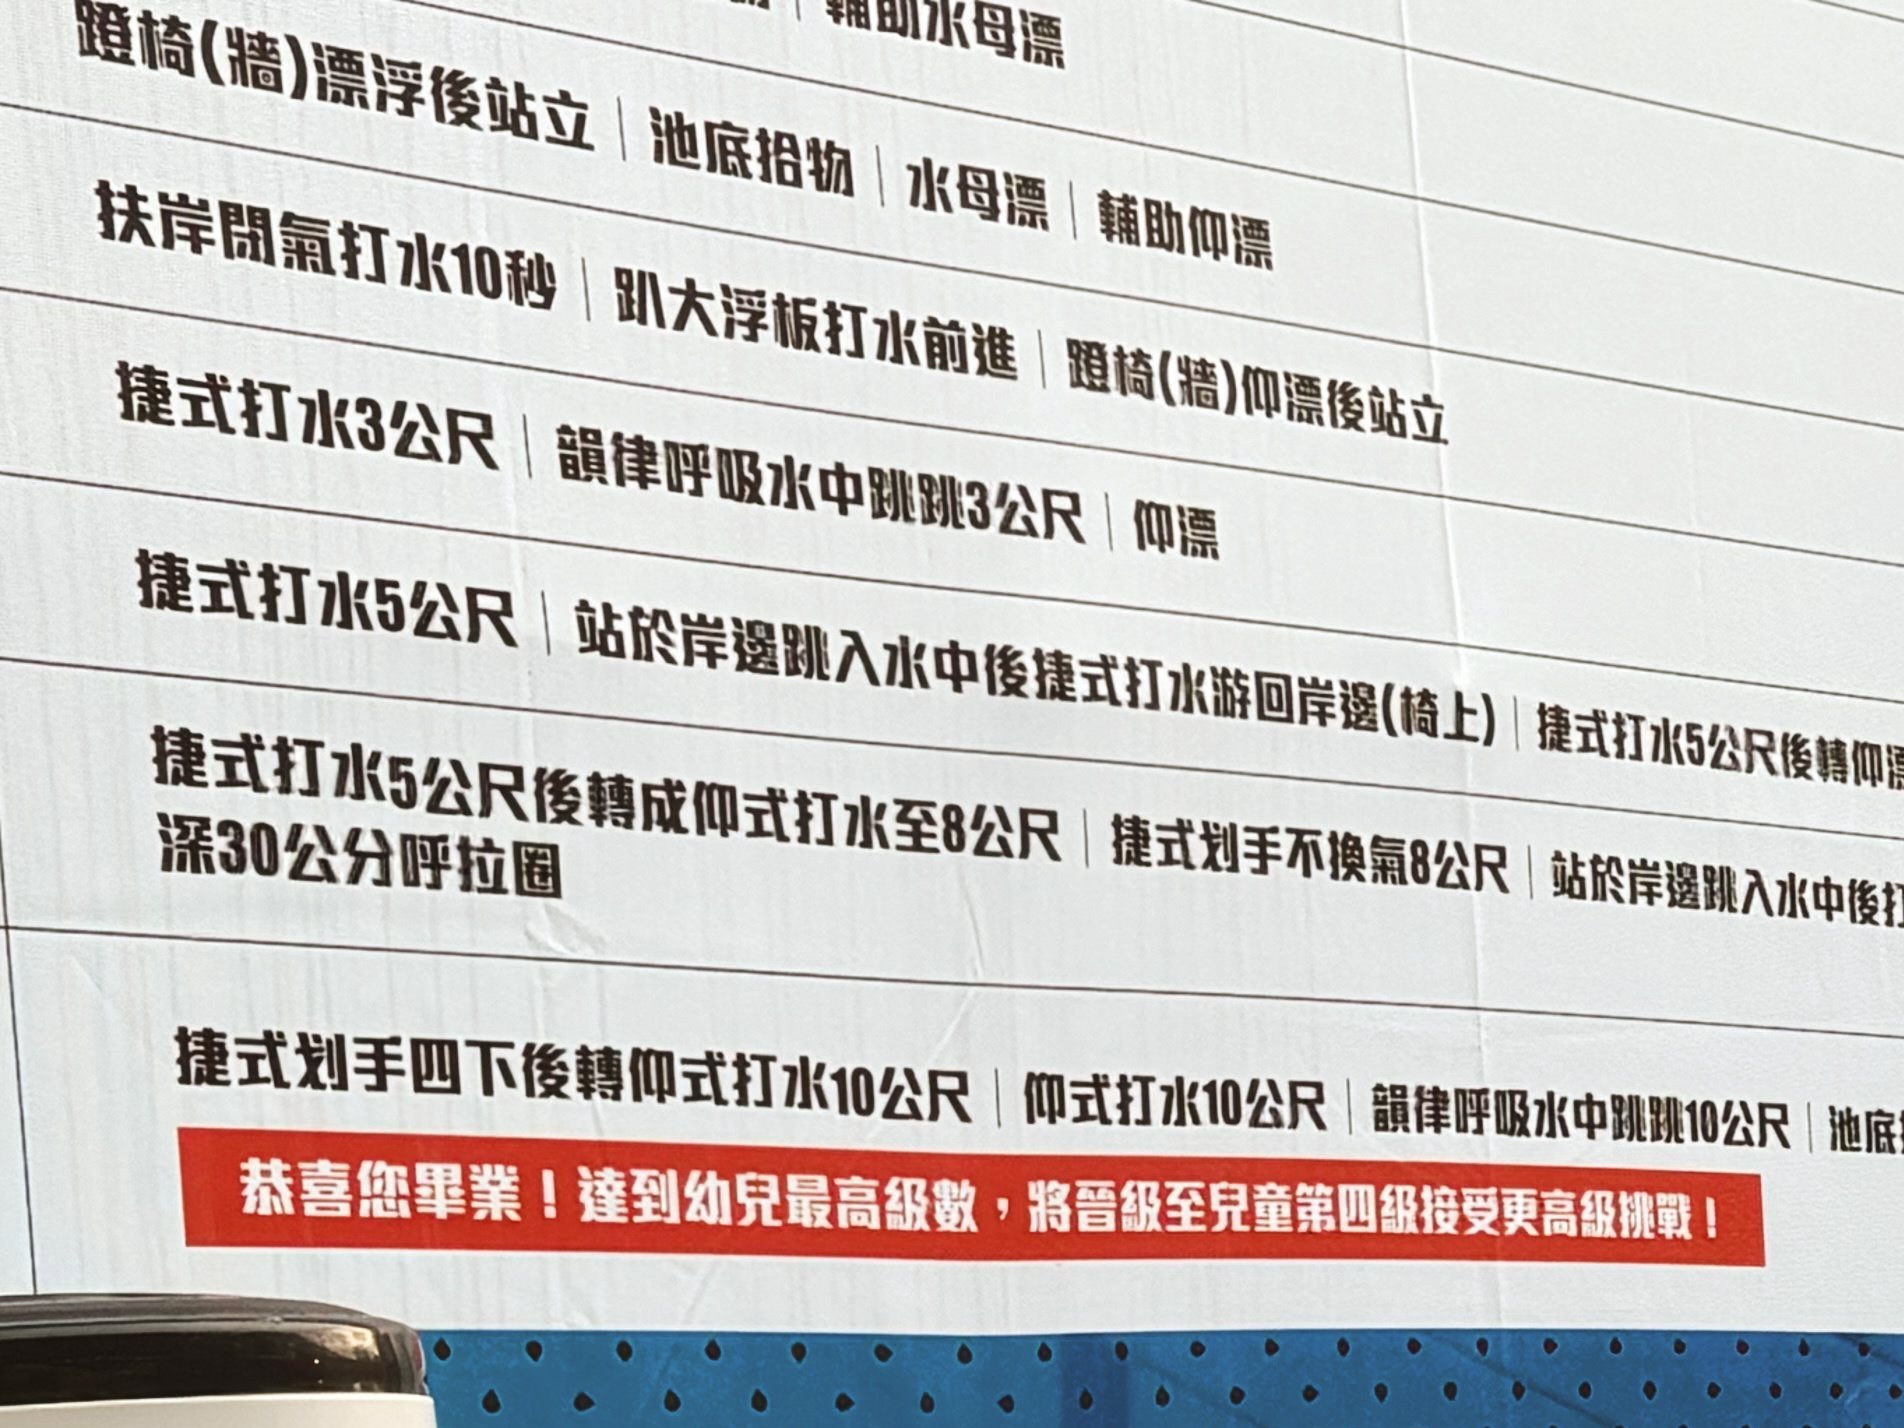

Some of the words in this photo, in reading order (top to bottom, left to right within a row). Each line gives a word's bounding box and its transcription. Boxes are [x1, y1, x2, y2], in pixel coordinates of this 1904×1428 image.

[77, 0, 595, 152] 蹬椅(牆)漂浮後站立
[650, 106, 855, 197] 池底拾物
[907, 157, 1050, 232] 水母漂
[1098, 189, 1274, 271] 輔助仰漂
[94, 178, 558, 311] 扶岸閉氣打水10秒
[614, 266, 1018, 381] 趴大浮板打水前進
[1066, 336, 1450, 447] 蹬椅(牆)仰漂後站立
[114, 361, 500, 471] 捷式打水3公尺
[558, 424, 1088, 546] 韻律呼吸水中跳跳3公尺
[1133, 497, 1221, 562] 仰漂
[136, 548, 519, 649] 捷式打水5公尺
[576, 600, 1495, 747] 站於岸邊跳入水中後捷式打水游回岸邊(椅上)
[150, 726, 1062, 864] 捷式打水5公尺後轉成仰式打水至8公尺
[1111, 814, 1509, 897] 捷式划手不換氣8公尺
[157, 811, 563, 902] 深30公分呼拉圈
[175, 1026, 972, 1125] 捷式划手四下後轉仰式打水10公尺
[1023, 1070, 1328, 1133] 仰式打水10公尺
[1372, 1081, 1792, 1152] 韻律呼吸水中跳跳10公尺
